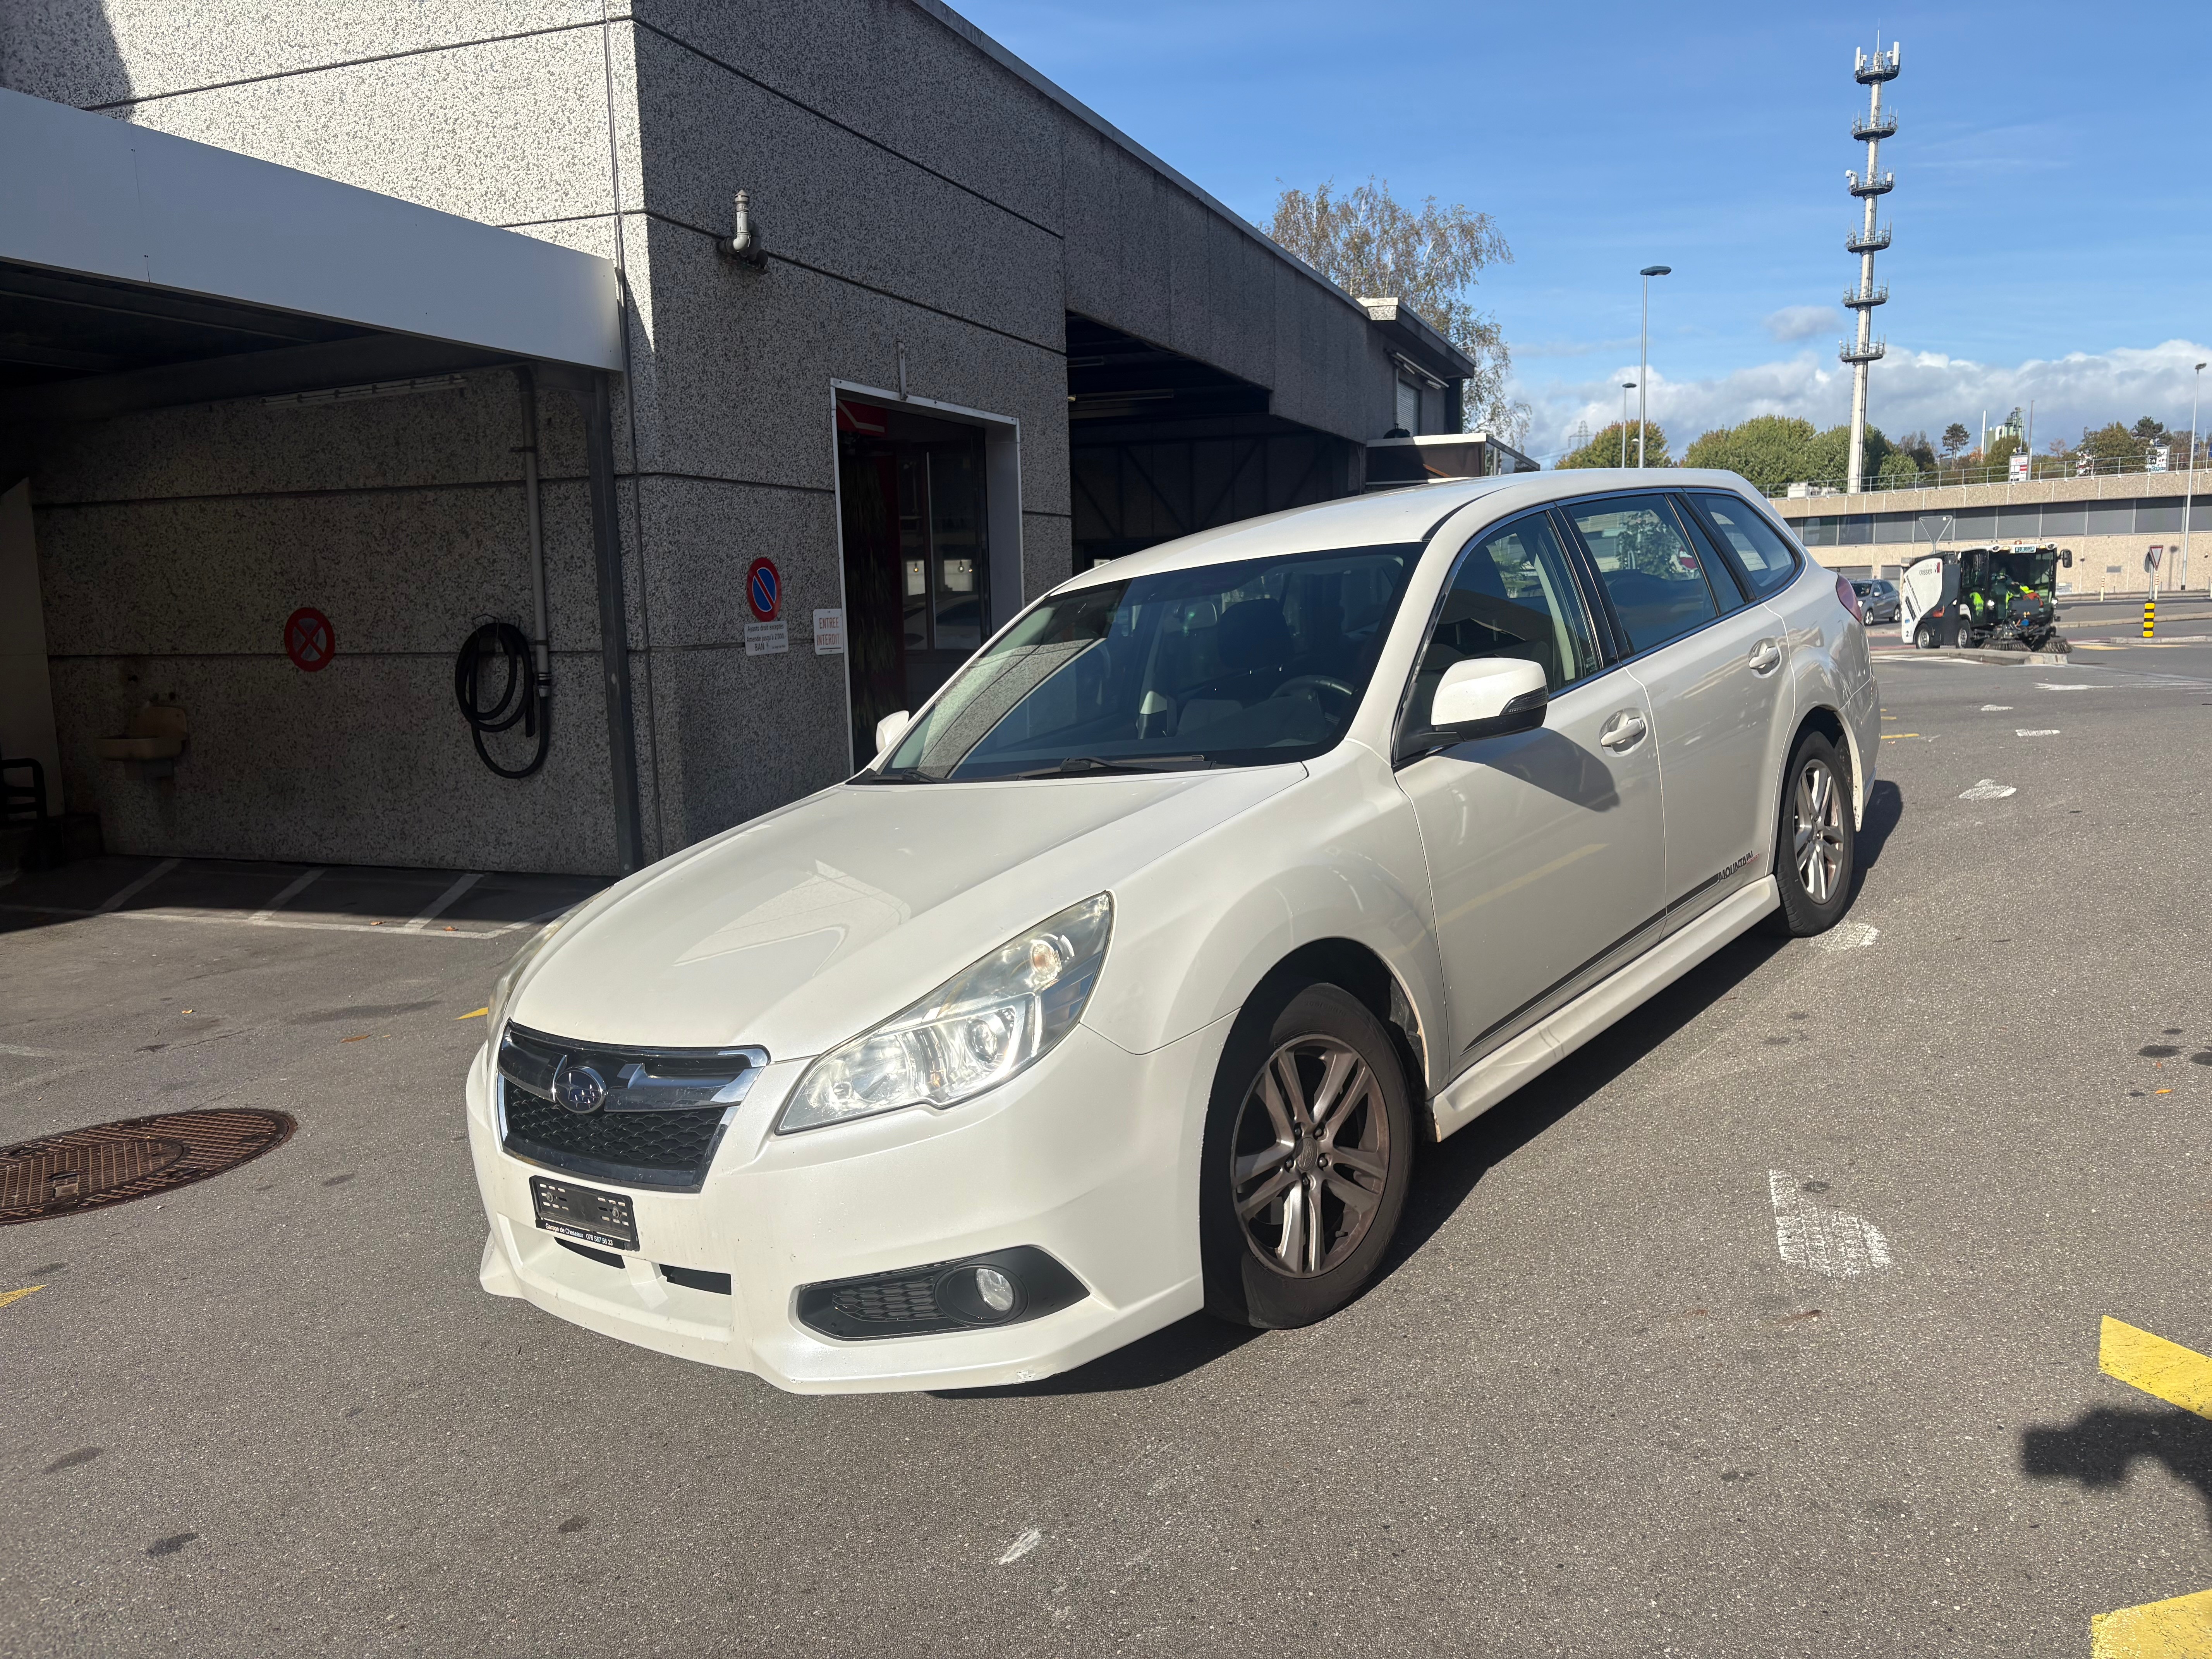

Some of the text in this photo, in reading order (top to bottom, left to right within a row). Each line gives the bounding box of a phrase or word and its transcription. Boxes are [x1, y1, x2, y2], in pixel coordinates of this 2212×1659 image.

[755, 643, 764, 651] BAN
[1719, 850, 1753, 880] MOUNTAIN
[545, 1223, 559, 1232] Garage
